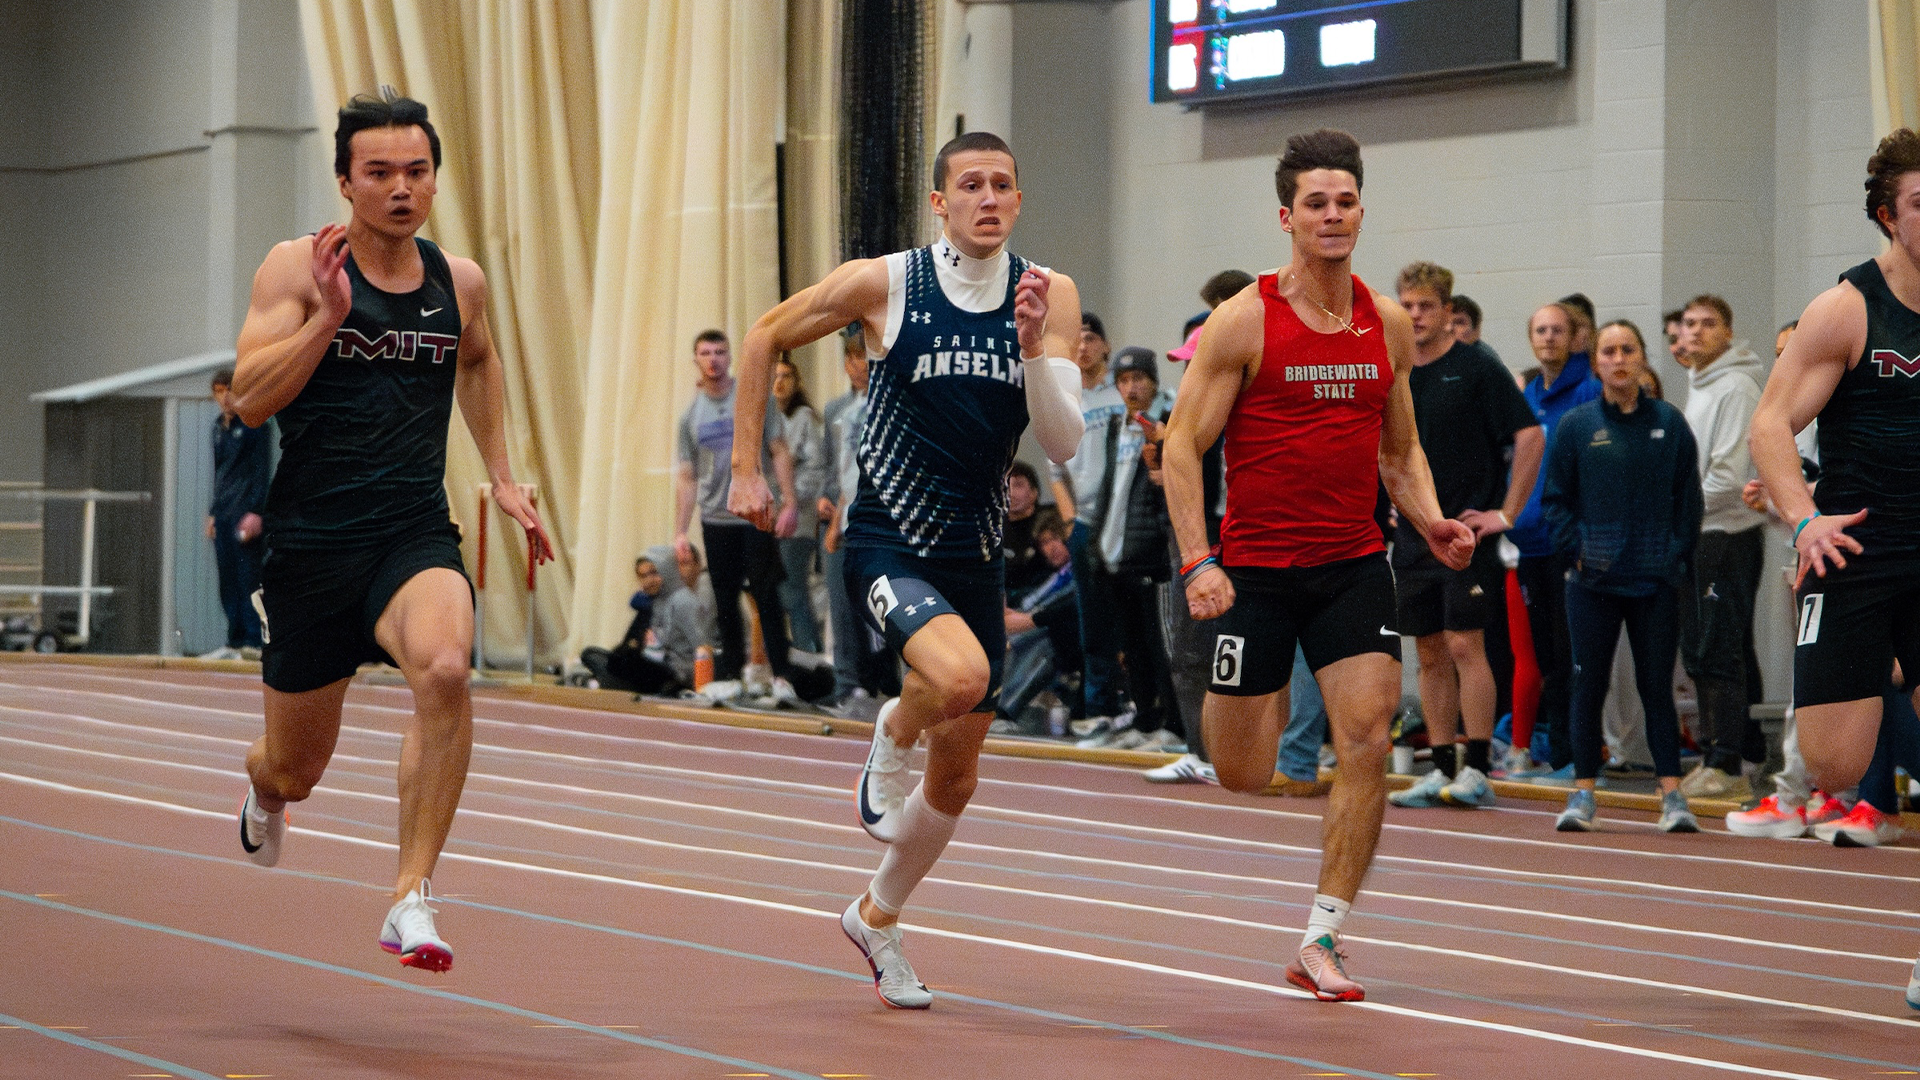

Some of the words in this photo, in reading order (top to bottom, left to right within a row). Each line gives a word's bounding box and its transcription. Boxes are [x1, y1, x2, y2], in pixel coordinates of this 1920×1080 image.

[331, 328, 458, 364] MIT
[933, 335, 1012, 354] SAINT
[911, 351, 1024, 389] ANSELM
[1284, 364, 1379, 382] BRIDGEWATER
[1313, 383, 1356, 399] STATE
[870, 582, 889, 622] 5
[1216, 638, 1237, 682] 6
